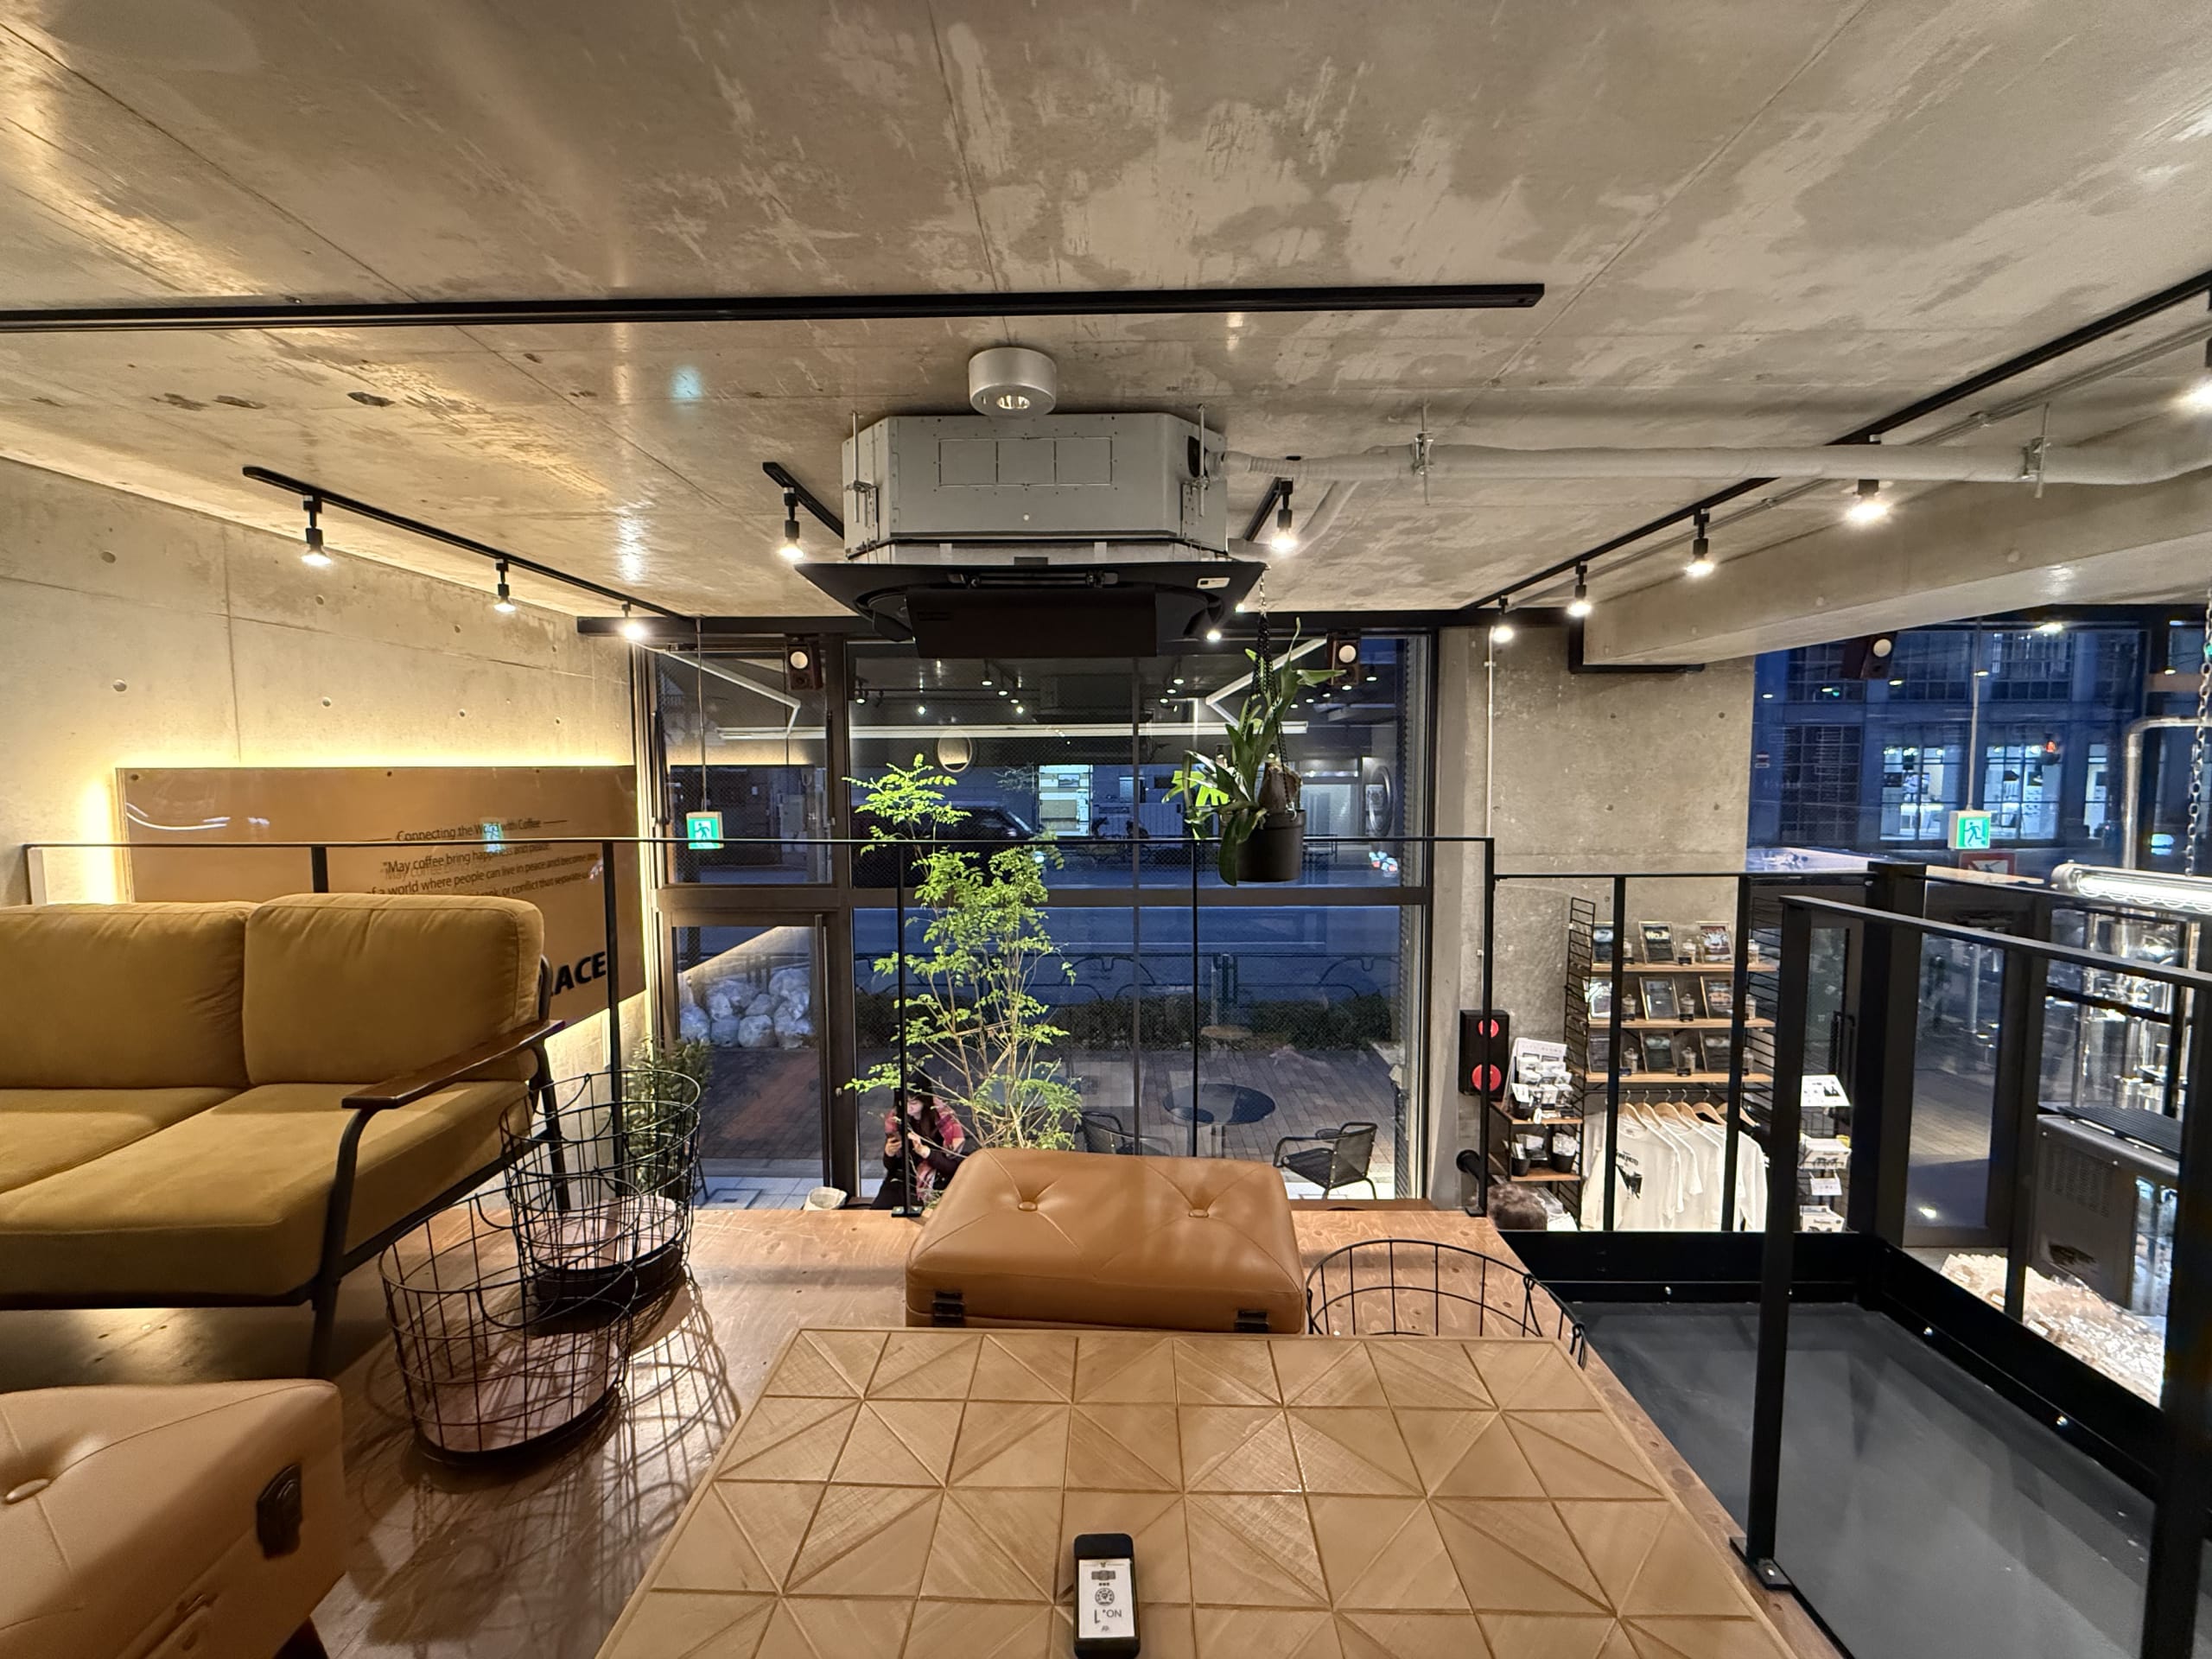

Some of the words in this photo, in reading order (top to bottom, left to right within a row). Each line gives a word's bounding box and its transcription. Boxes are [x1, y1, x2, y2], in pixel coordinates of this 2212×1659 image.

[397, 828, 456, 842] Connecting
[457, 824, 474, 836] the
[413, 855, 444, 870] coffee
[446, 851, 471, 865] bring
[514, 845, 528, 855] and
[388, 880, 418, 894] world
[420, 877, 452, 890] where
[454, 871, 484, 887] people
[486, 868, 500, 880] can
[502, 866, 515, 876] live
[516, 863, 524, 873] in
[525, 861, 545, 873] peace
[547, 856, 560, 868] and
[502, 887, 511, 896] or
[512, 879, 539, 893] conflict
[551, 951, 606, 995] ACE
[1094, 1609, 1101, 1624] 1
[1102, 1609, 1122, 1618] NO.
